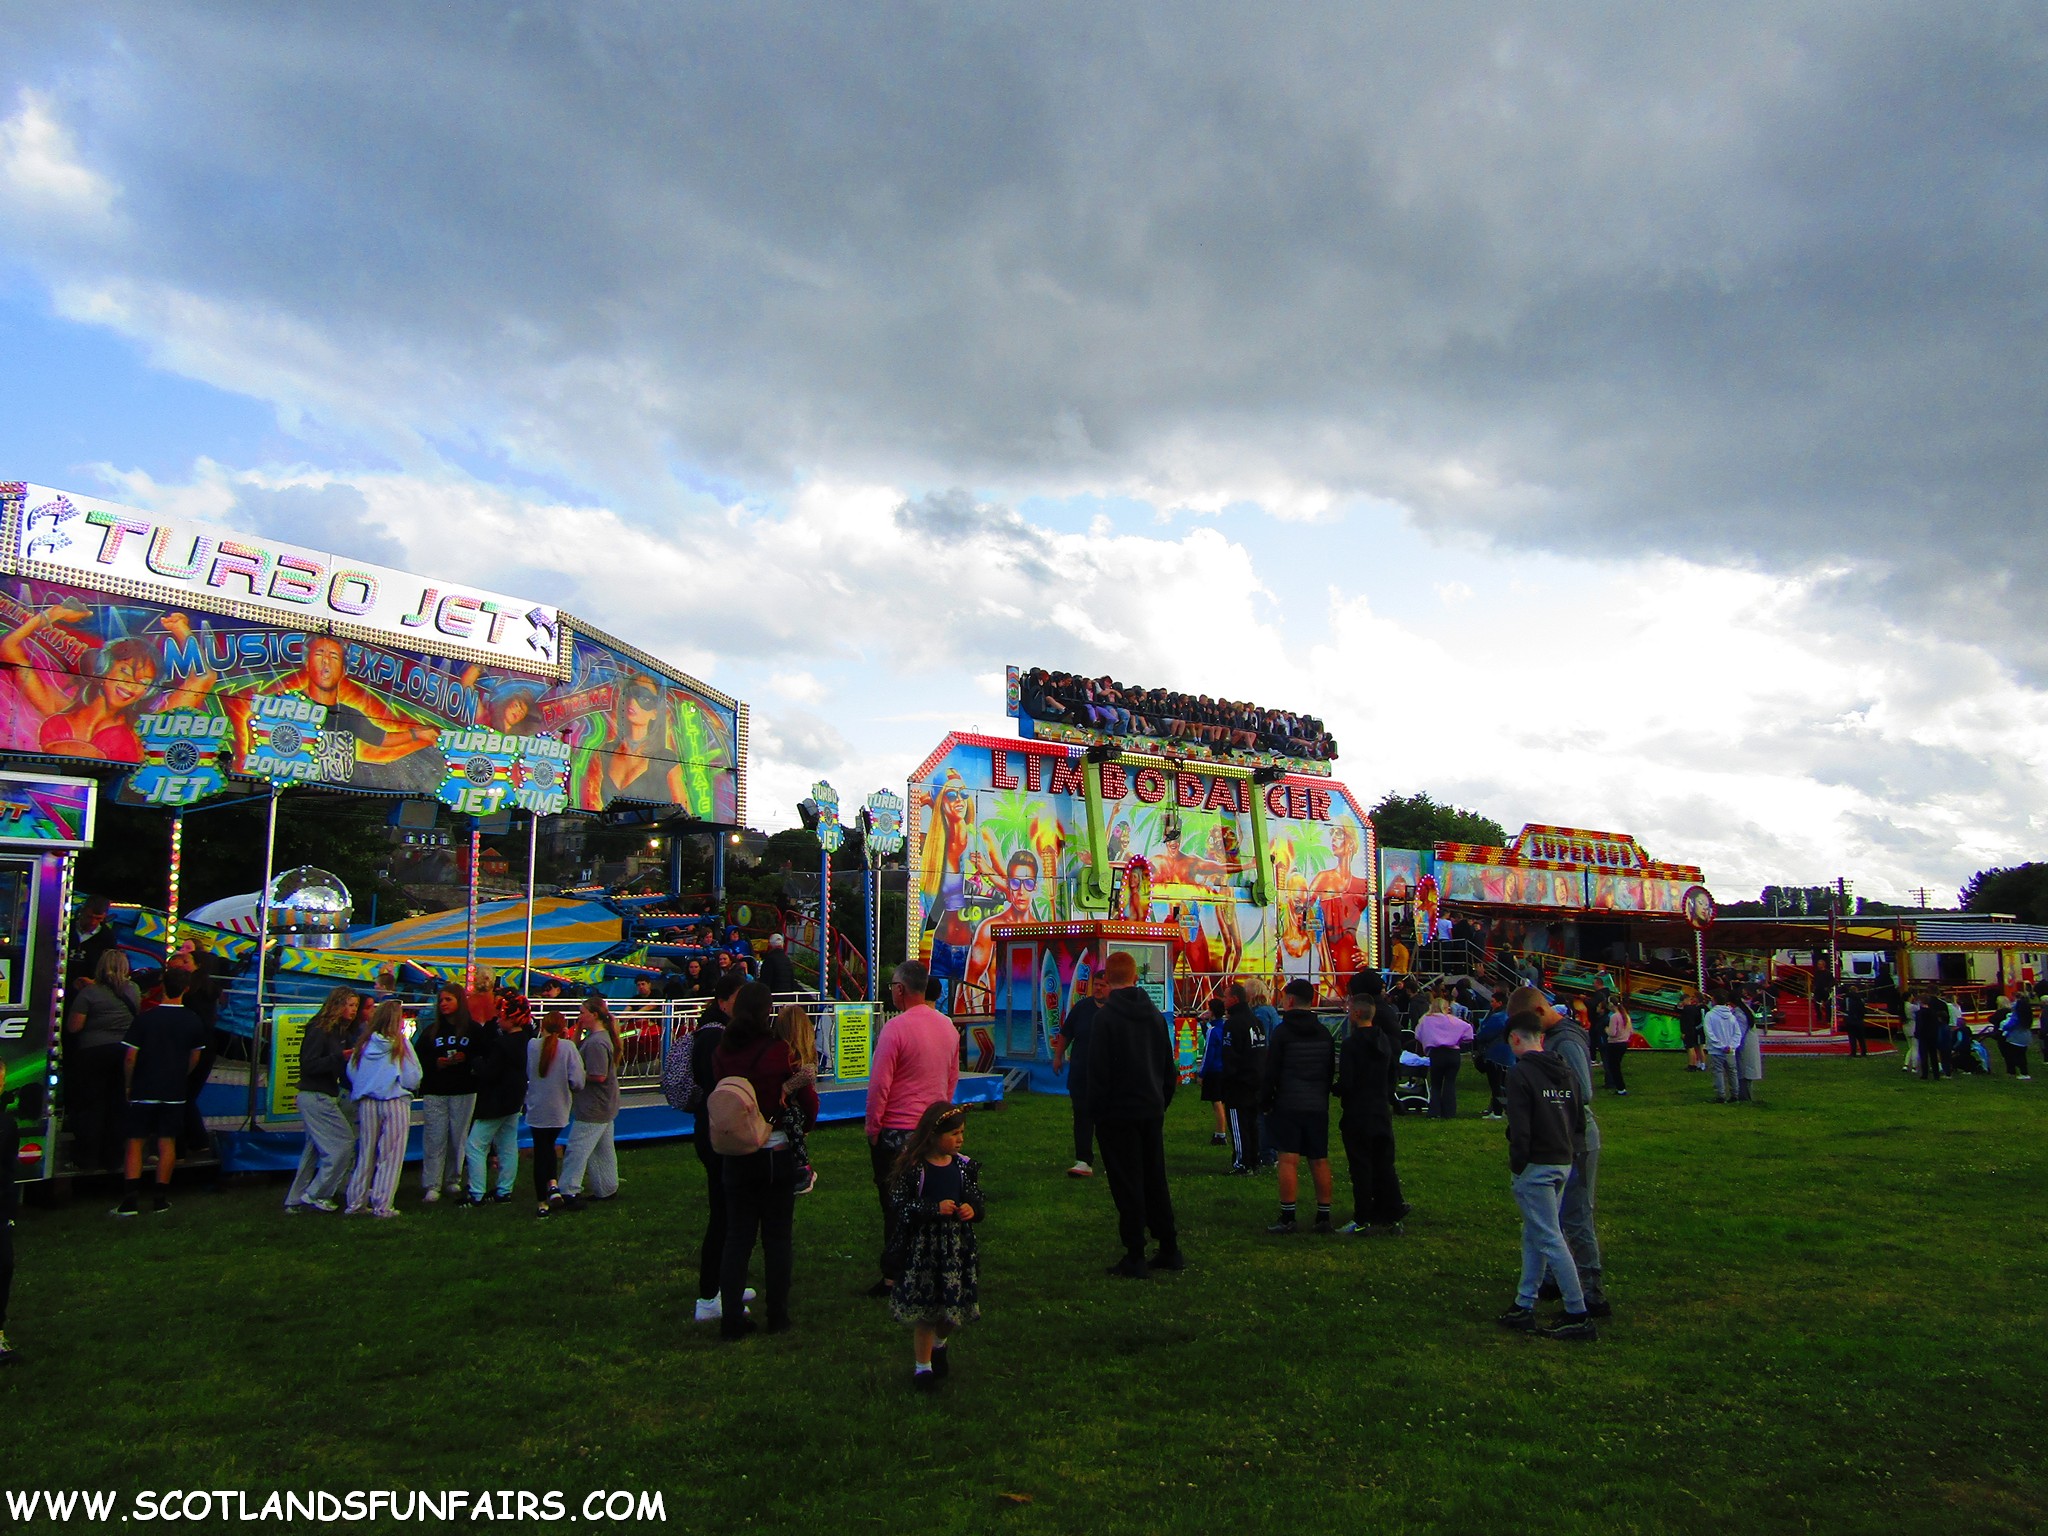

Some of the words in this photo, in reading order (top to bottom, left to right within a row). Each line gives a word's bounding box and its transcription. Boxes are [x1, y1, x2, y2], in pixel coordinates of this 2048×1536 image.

[86, 510, 382, 616] TURBO
[401, 587, 522, 645] JET
[163, 632, 307, 681] MUSIC
[347, 641, 480, 726] EXPLOSION
[251, 695, 327, 723] TURBO
[542, 687, 610, 728] EXTREME
[139, 713, 231, 738] TURBO
[440, 730, 516, 753] TURBO
[518, 735, 571, 759] TURBO
[243, 755, 322, 782] POWER
[681, 700, 711, 814] ULTIMATE
[147, 776, 211, 804] JET
[451, 788, 506, 813] JET
[517, 789, 567, 811] TIME
[812, 783, 839, 804] TURBO
[868, 793, 904, 809] TURBO
[822, 831, 839, 851] JET
[869, 835, 902, 853] TIME
[434, 1035, 470, 1047] EGO
